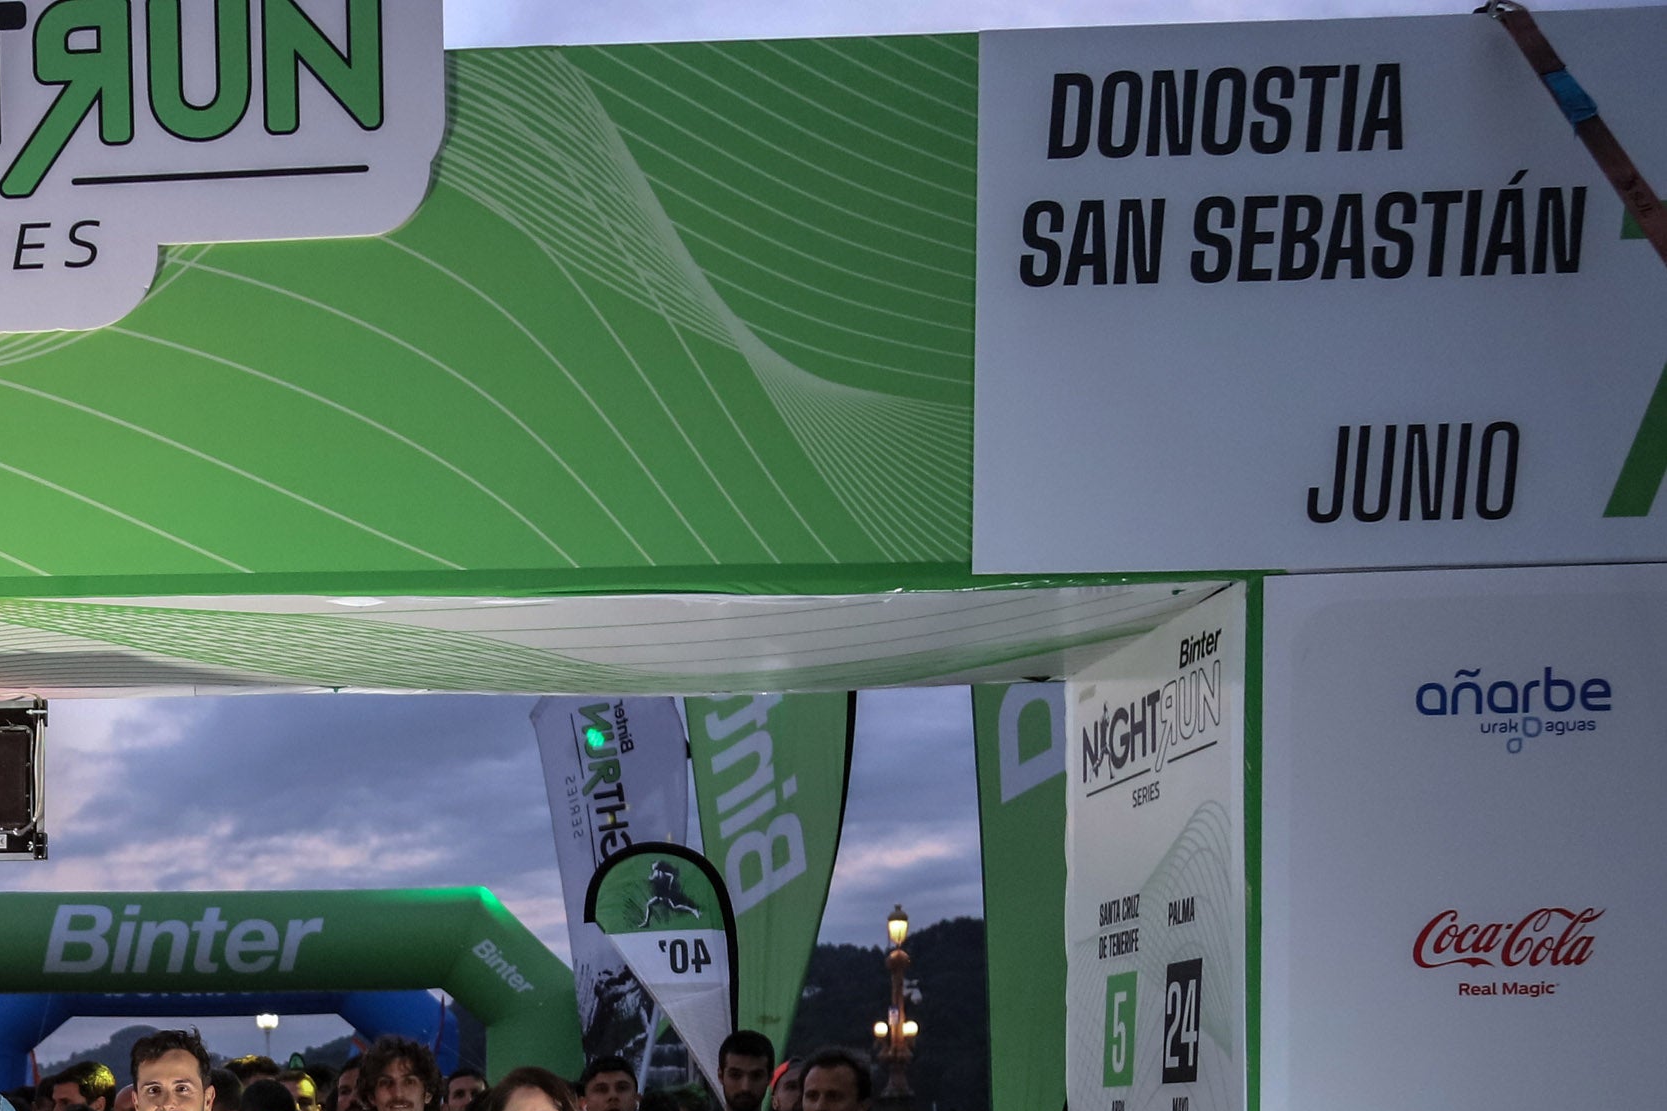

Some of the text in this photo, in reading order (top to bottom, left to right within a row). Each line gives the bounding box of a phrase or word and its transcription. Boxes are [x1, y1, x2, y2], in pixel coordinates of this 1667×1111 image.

[1047, 63, 1404, 160] DONOSTIA
[1019, 169, 1588, 288] SAN SEBASTIÁN
[1307, 421, 1521, 524] JUNIO
[1180, 627, 1222, 670] Binter
[1415, 667, 1612, 717] añarbe
[1481, 719, 1596, 736] urak aguas
[1132, 780, 1160, 808] SERIES
[1099, 894, 1140, 928] SANTA CRUZ
[1168, 896, 1195, 927] PALMA
[1413, 907, 1606, 969] Coca-Cola
[42, 903, 324, 976] Binter
[1099, 928, 1139, 960] DE TENERIFE
[473, 938, 534, 997] Binter
[1459, 981, 1555, 998] Real Magic
[1112, 991, 1127, 1074] 5
[1165, 979, 1198, 1070] 24
